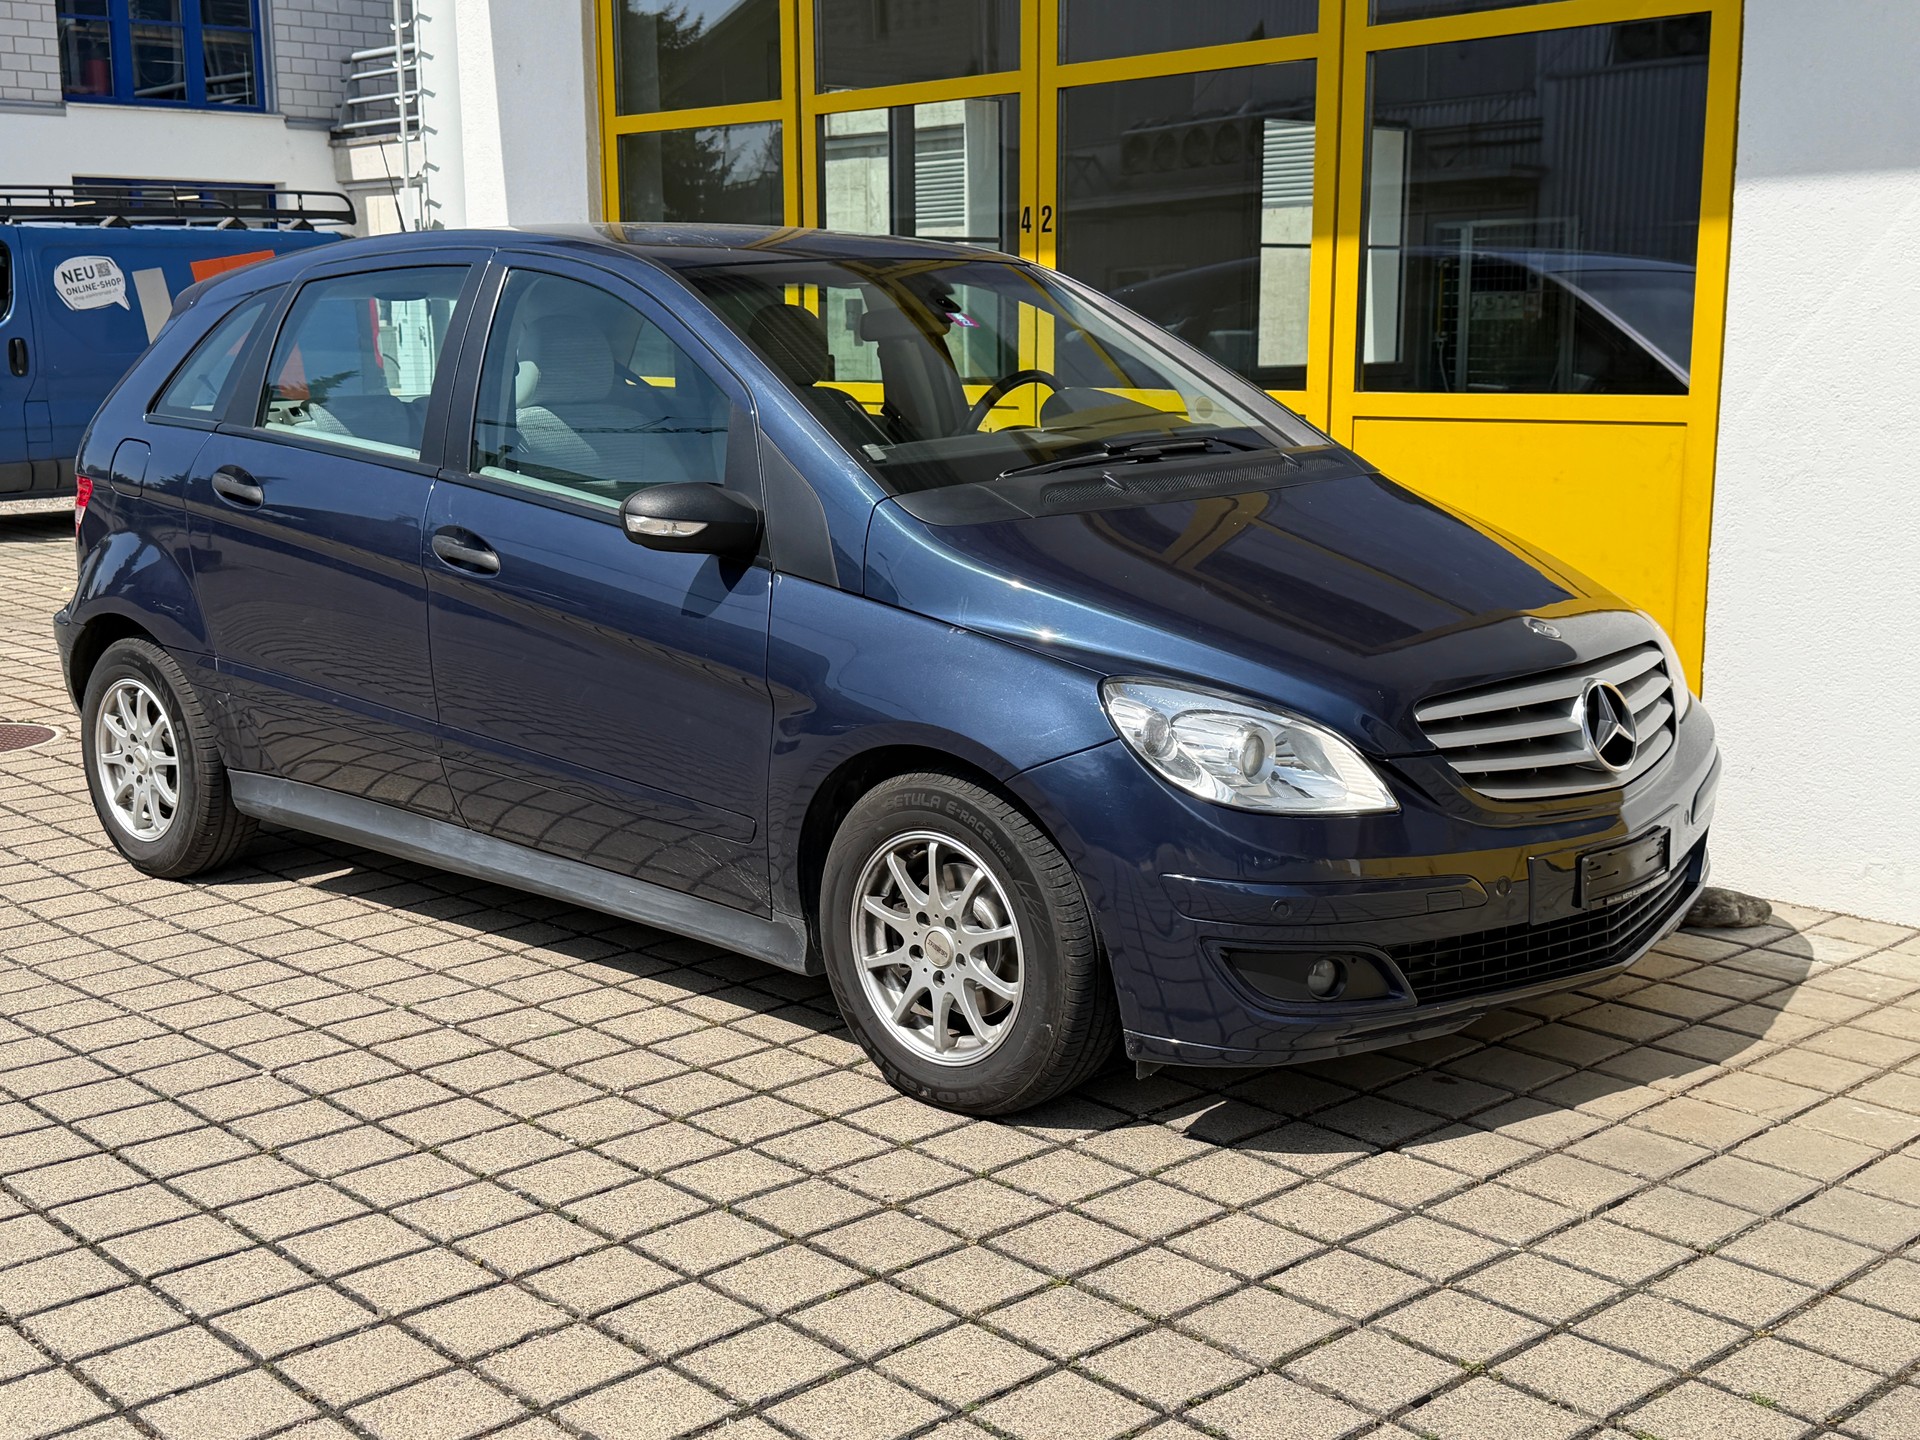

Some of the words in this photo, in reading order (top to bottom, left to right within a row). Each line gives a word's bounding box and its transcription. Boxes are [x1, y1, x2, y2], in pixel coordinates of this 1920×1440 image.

[61, 265, 95, 285] NEU
[66, 277, 122, 296] ONLINE-SHOP
[945, 800, 994, 841] E-RACE
